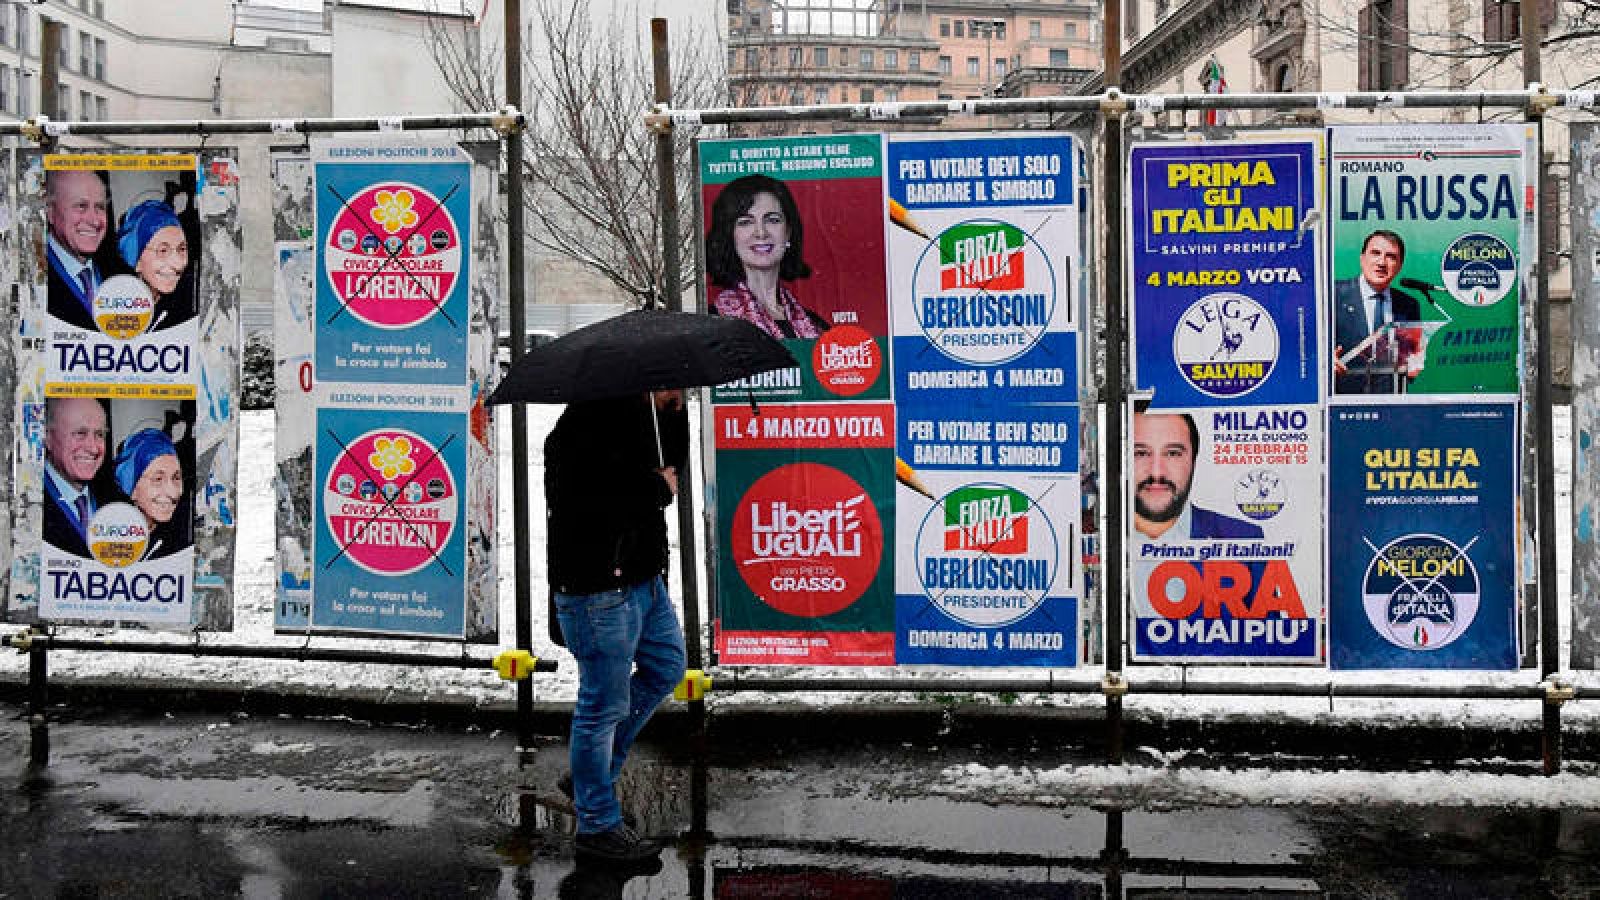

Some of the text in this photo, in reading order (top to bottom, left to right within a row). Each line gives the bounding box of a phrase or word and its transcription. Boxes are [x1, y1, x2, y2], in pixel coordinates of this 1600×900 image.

[900, 154, 1061, 179] PER VOTARE DEVI SOLO
[1167, 160, 1276, 188] PRIMA
[1340, 161, 1404, 173] ROMANO
[906, 179, 1056, 204] BARRARE IL SIMBOLO
[1203, 188, 1242, 206] GLI
[1340, 174, 1517, 221] LA RUSSA
[1151, 206, 1294, 234] ITALIANI
[956, 231, 1008, 264] FORZA
[1161, 242, 1287, 255] SALVINI PREMIER
[1451, 249, 1507, 260] MELONI
[343, 259, 443, 271] CIVICA POPOLARE
[956, 252, 1012, 287] ITALIA
[346, 275, 441, 300] LORENZIN
[1146, 268, 1302, 287] 4 MARZO VOTA
[923, 294, 1046, 329] BERLUSCONI
[1185, 299, 1261, 333] LEGA
[943, 334, 1025, 347] PRESIDENTE
[52, 343, 190, 374] TABACCI
[716, 368, 801, 388] LDRINI
[908, 368, 1065, 389] DOMENICA 4 MARZO
[1191, 363, 1264, 381] SALVINI
[725, 416, 885, 438] IL 4 MARZO VOTA
[1213, 410, 1308, 431] MILANO
[908, 421, 1068, 443] PER VOTARE DEVI SOLO
[1213, 432, 1308, 443] PIAZZA DUOMO
[914, 445, 1062, 467] BARRARE IL SIMBOLO
[1213, 443, 1308, 455] 24 FEBBRAIO
[1364, 447, 1480, 468] QUI SI FA
[1213, 455, 1308, 465] SABATO ORE 15
[1366, 470, 1479, 490] L'ITALIA.
[341, 503, 440, 519] CIVICA POPOLARE
[960, 494, 1012, 527] FORZA
[343, 520, 437, 548] LORENZIN
[960, 517, 1015, 549] ITALIA
[753, 533, 861, 557] UGUALI
[1141, 543, 1195, 557] Prima
[1200, 543, 1223, 560] gli
[1388, 546, 1453, 559] GIORGIA
[926, 558, 1047, 590] BERLUSCONI
[1377, 560, 1465, 577] MELONI
[46, 569, 184, 604] TABACCI
[770, 577, 846, 592] GRASSO
[1147, 560, 1308, 619] ORA
[944, 595, 1027, 609] PRESIDENTE
[908, 629, 1064, 650] DOMENICA 4 MARZO
[1147, 620, 1174, 643] O
[1178, 620, 1240, 643] MAI
